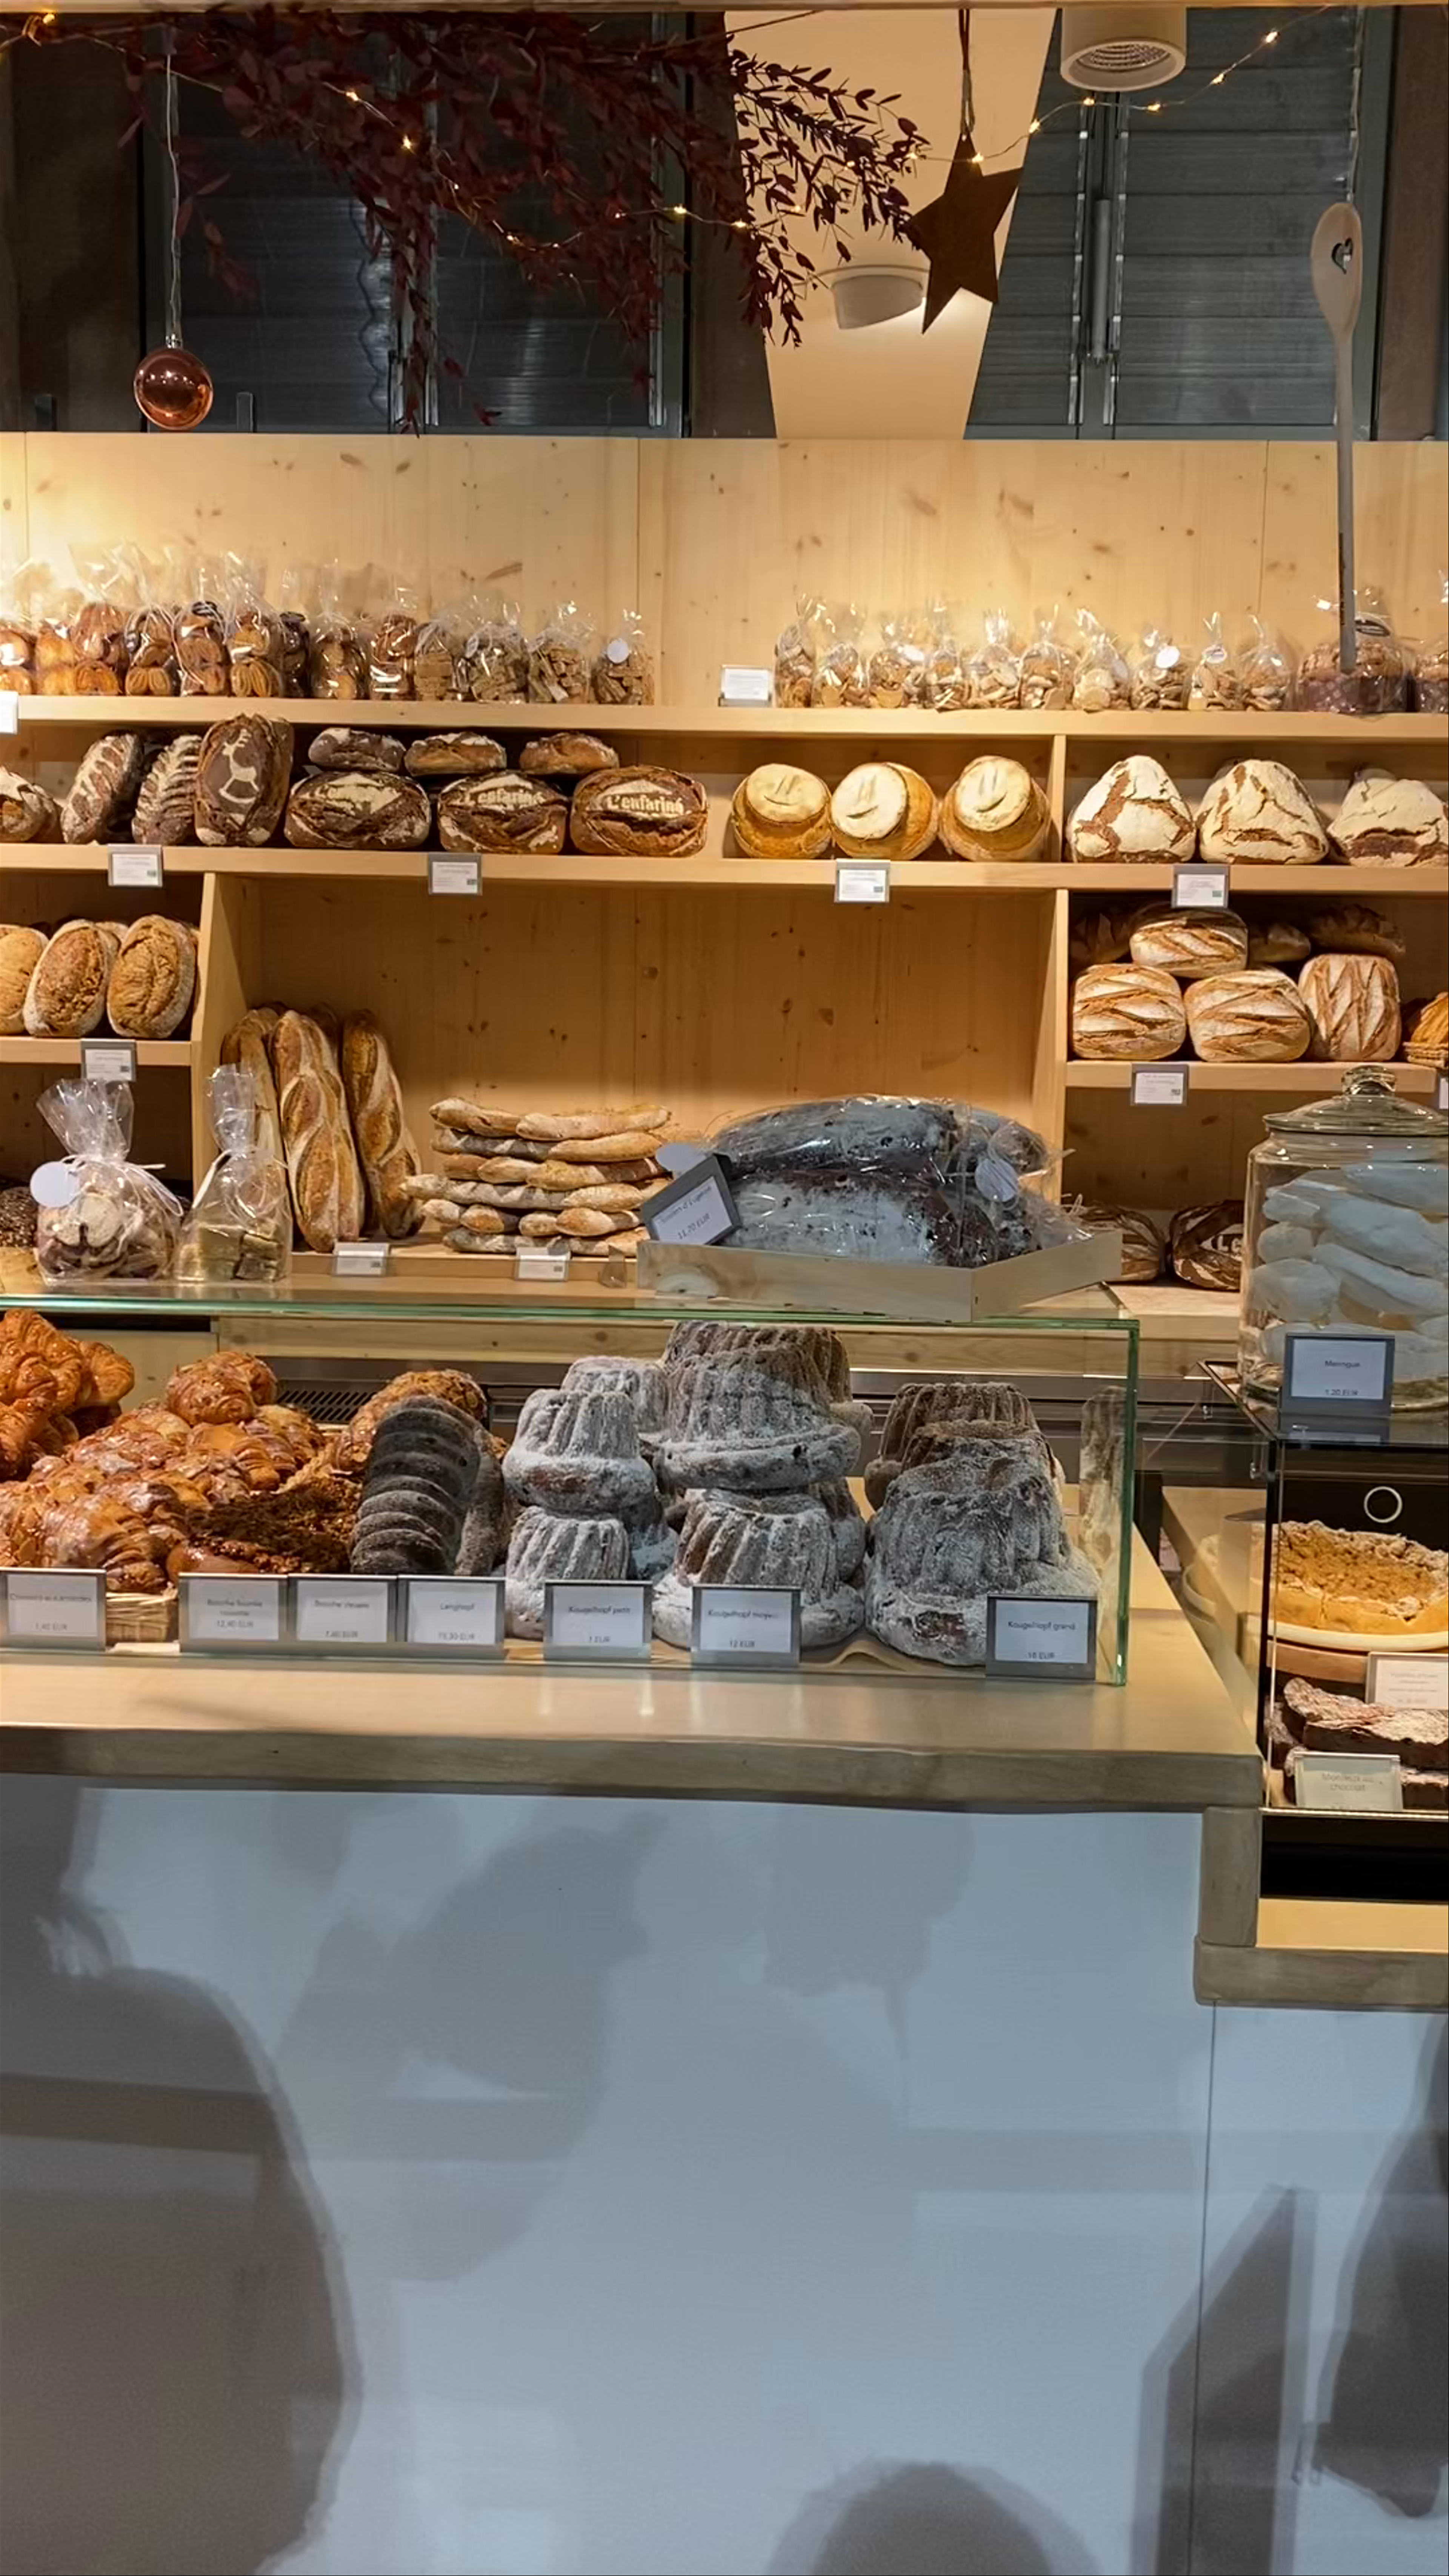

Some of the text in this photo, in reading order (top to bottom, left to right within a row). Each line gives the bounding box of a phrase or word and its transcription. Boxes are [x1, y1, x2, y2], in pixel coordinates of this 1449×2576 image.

[1324, 1360, 1361, 1369] Meringue
[1008, 1621, 1076, 1631] Kougelhopf grand
